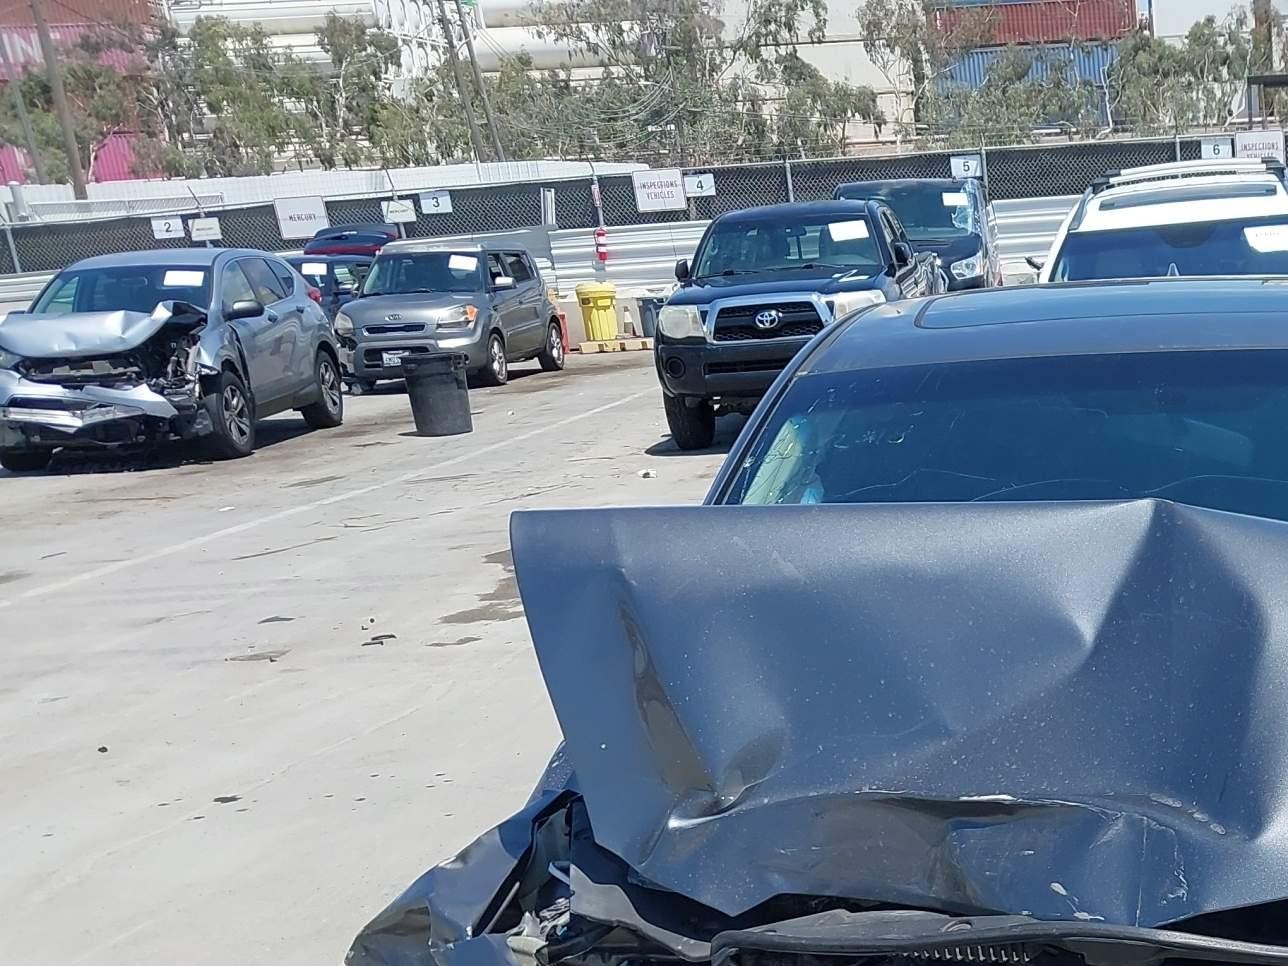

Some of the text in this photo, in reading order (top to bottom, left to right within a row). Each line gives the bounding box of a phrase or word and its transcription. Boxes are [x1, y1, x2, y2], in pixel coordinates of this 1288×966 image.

[1212, 143, 1221, 155] 6
[1240, 142, 1279, 151] INSPECTIONS
[962, 161, 970, 172] 5
[640, 180, 678, 190] INSPECTIONS
[696, 179, 704, 191] 4
[646, 190, 675, 200] VEHICLES
[431, 196, 440, 208] 3
[288, 213, 317, 222] MERCURY
[163, 221, 172, 233] 2
